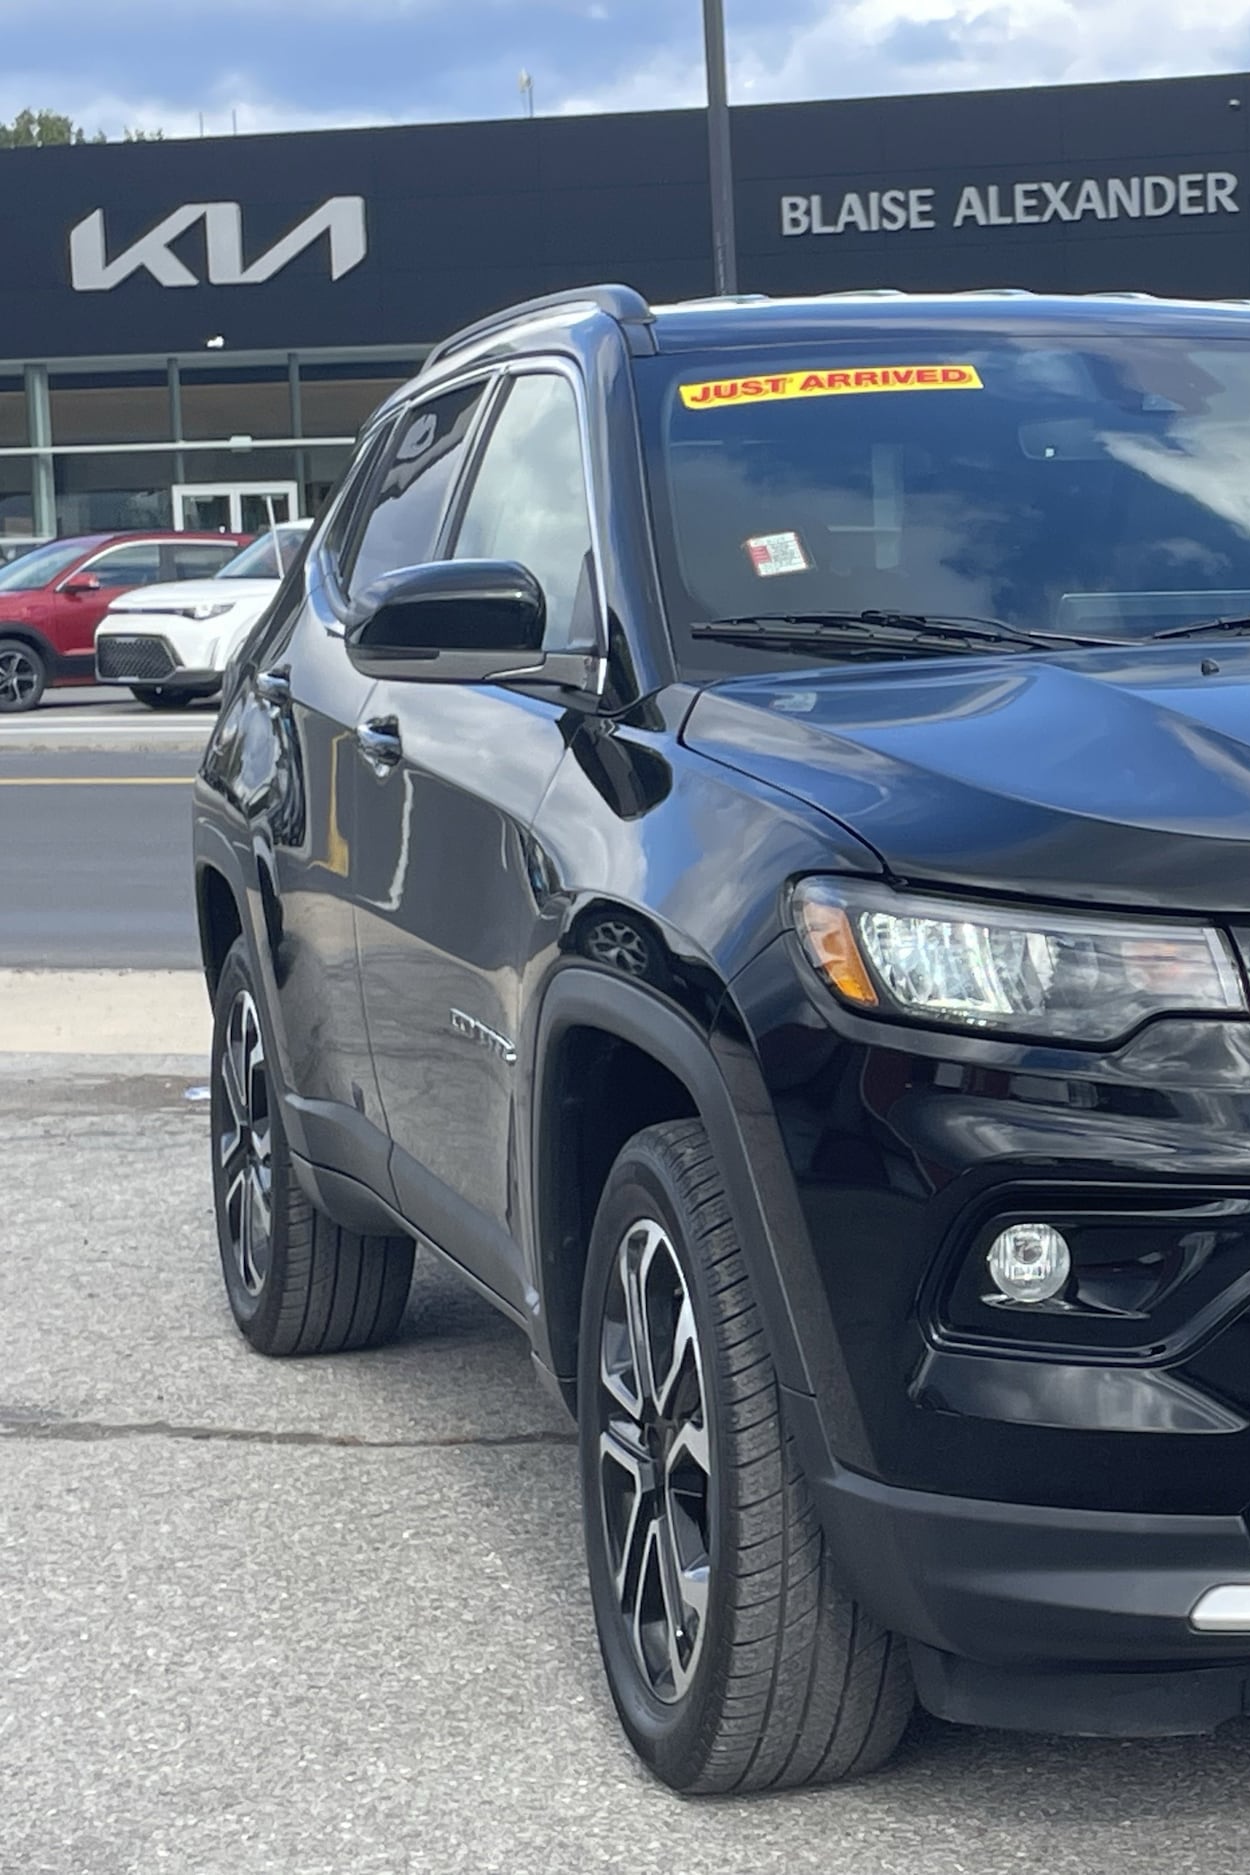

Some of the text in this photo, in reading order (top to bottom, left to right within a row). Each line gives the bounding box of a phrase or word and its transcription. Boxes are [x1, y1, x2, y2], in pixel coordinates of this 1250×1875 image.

[781, 171, 1239, 236] BLAISE ALEXANDER
[690, 368, 972, 403] JUST ARRIVED
